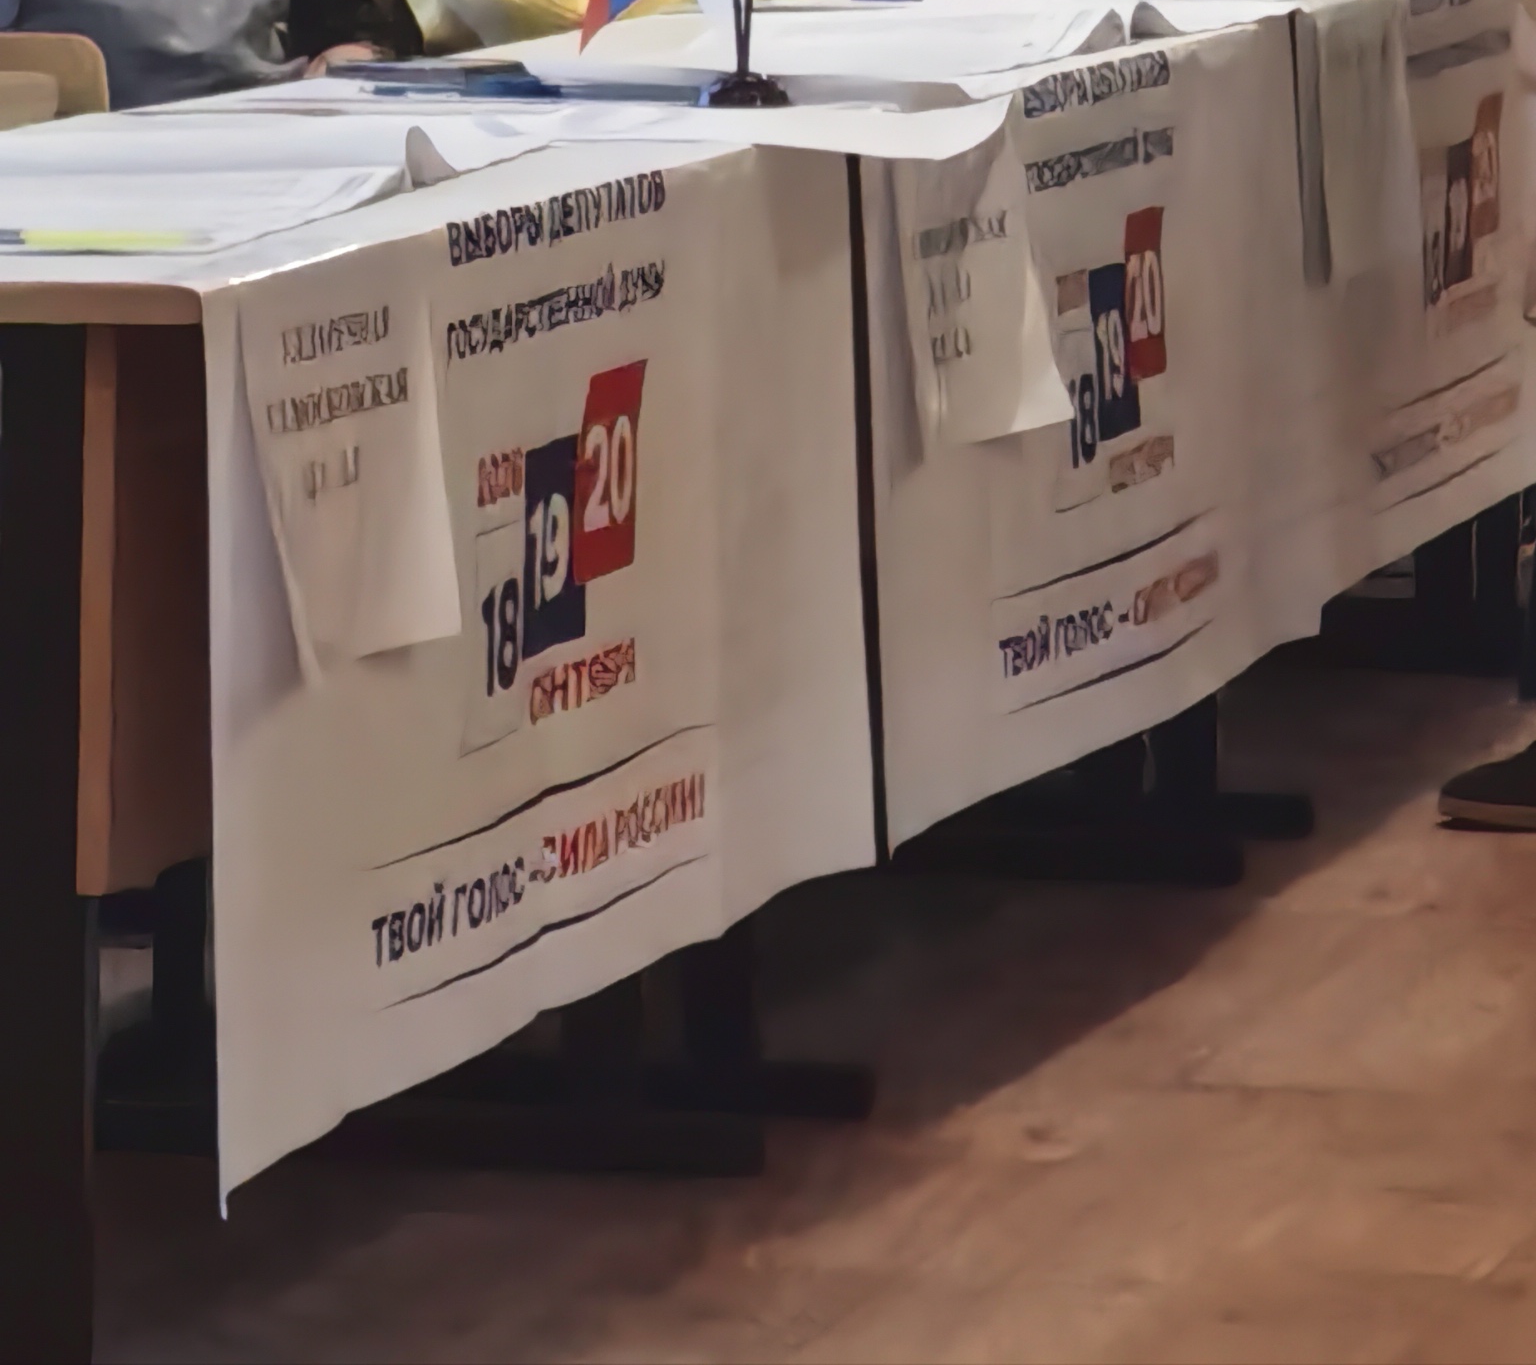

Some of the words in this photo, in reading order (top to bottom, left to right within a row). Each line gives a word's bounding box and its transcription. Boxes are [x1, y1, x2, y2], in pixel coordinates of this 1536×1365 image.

[446, 200, 545, 267] ВЫБОРЫ
[582, 414, 635, 533] 20
[528, 491, 571, 612] 19
[480, 577, 520, 698] 18
[371, 879, 445, 968] ТВОЙ
[452, 855, 526, 937] ГОЛОС
